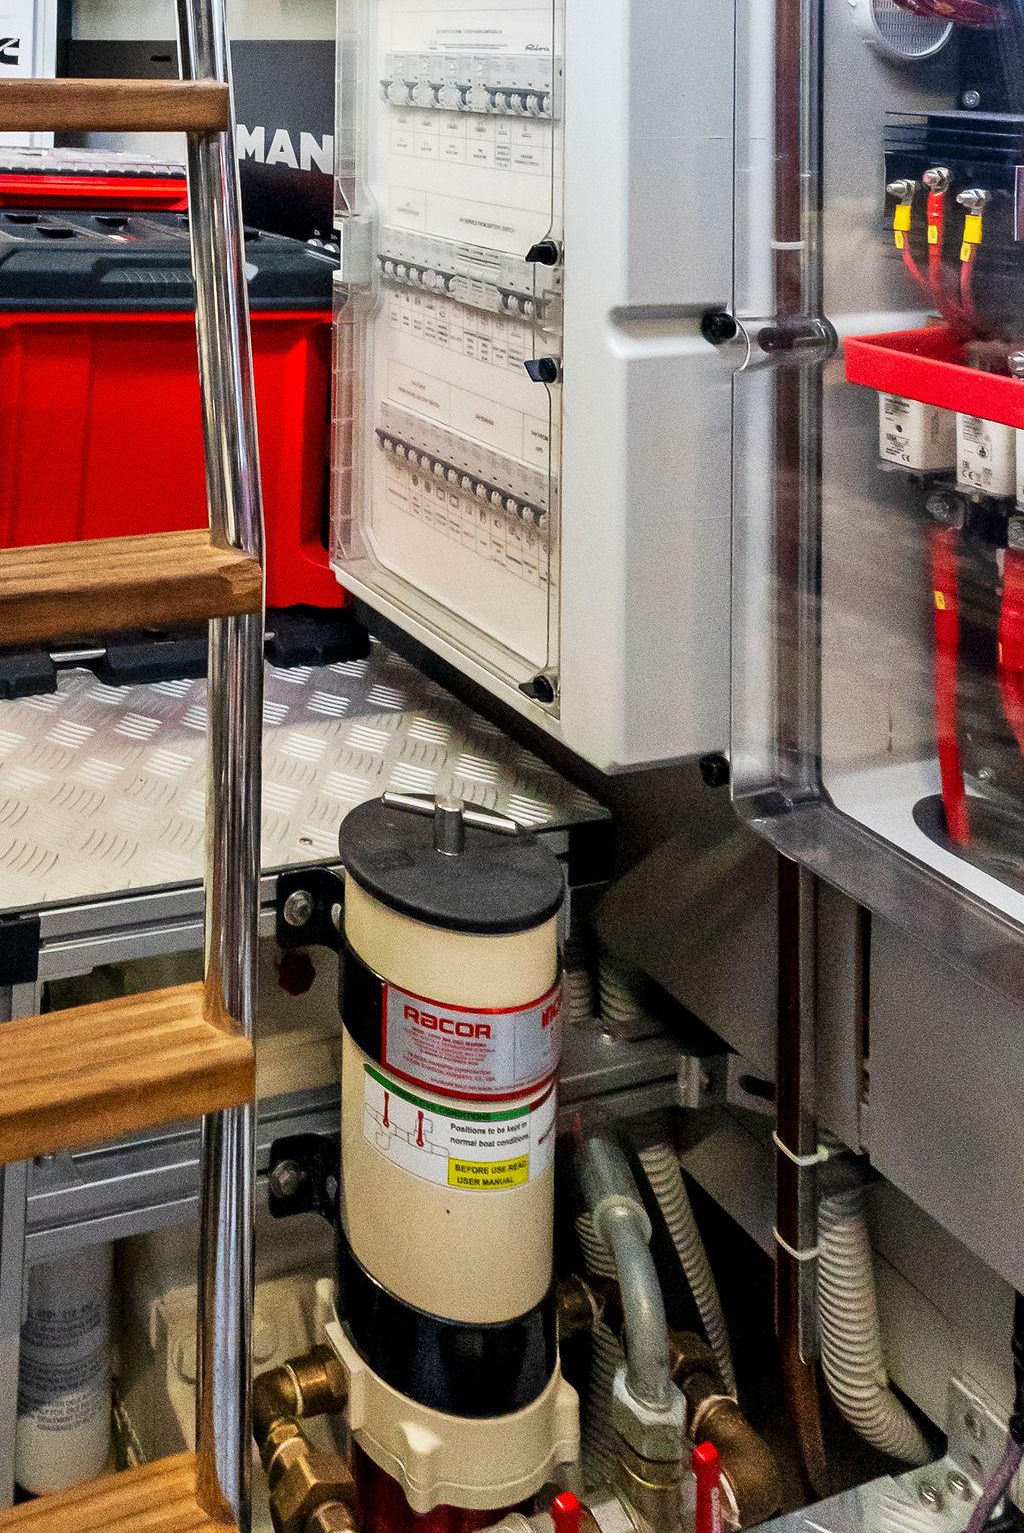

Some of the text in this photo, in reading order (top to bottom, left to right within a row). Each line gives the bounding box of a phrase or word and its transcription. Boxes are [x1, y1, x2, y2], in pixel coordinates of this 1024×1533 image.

[236, 123, 334, 176] MAN
[450, 1123, 486, 1135] Positions
[488, 1127, 496, 1135] to
[497, 1126, 506, 1134] be
[507, 1123, 521, 1134] kept
[450, 1137, 477, 1148] normal
[478, 1139, 495, 1148] boat
[455, 1163, 490, 1175] BEFORE
[491, 1164, 507, 1174] USE
[456, 1176, 514, 1187] USER MANUAL
